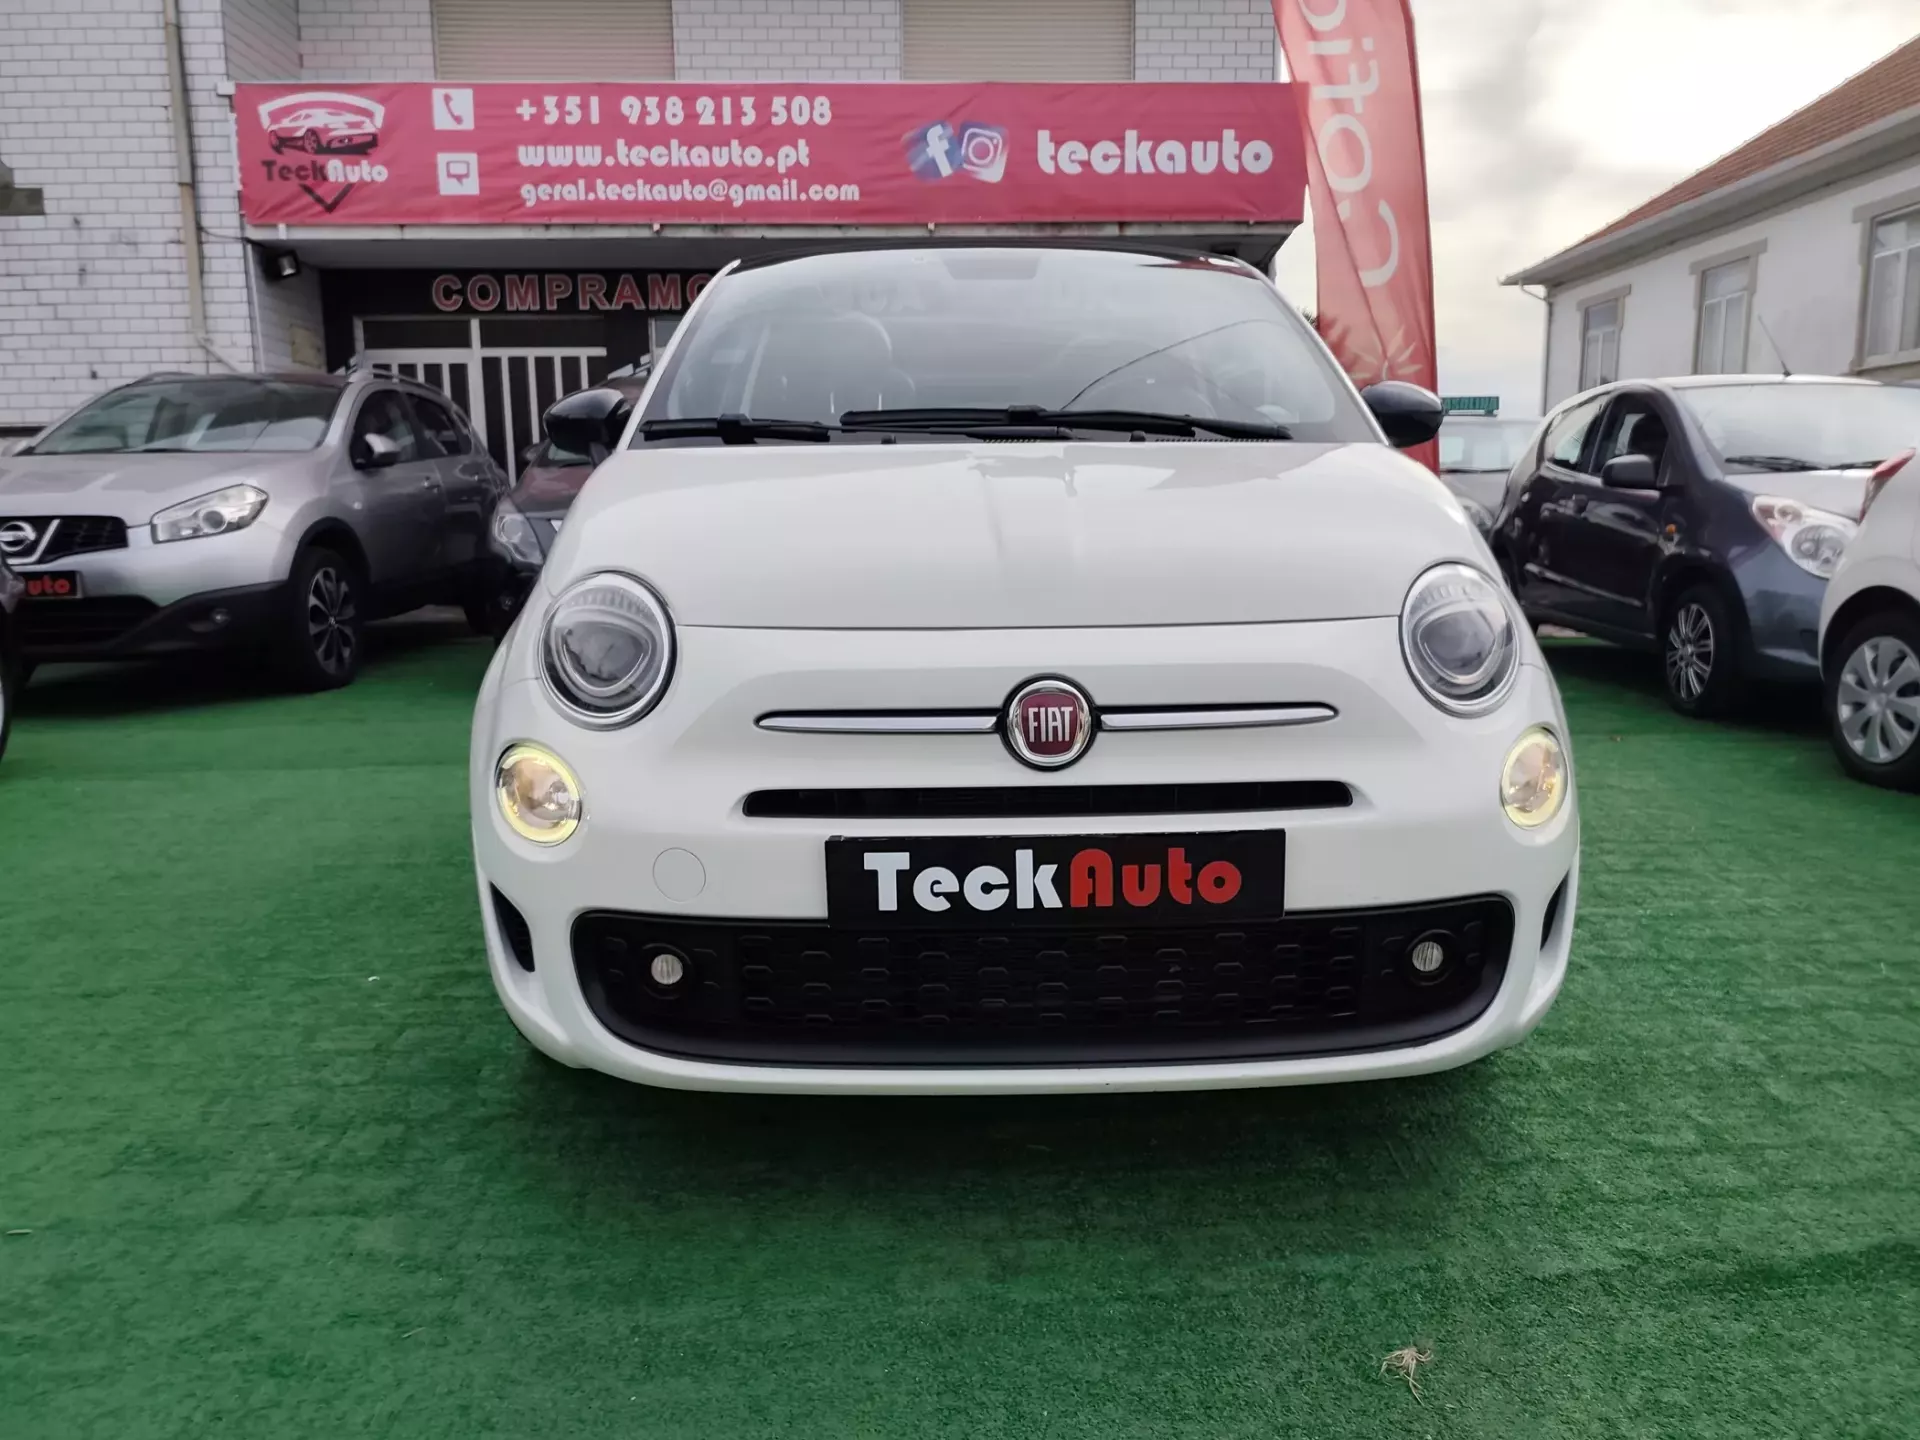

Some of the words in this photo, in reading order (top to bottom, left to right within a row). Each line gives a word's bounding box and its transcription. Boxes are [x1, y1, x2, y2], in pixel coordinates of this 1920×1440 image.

[516, 96, 600, 126] +351
[621, 96, 685, 126] 938
[697, 96, 757, 126] 213
[772, 96, 832, 126] 508
[518, 139, 810, 173] www.teckauto.pt
[1037, 130, 1273, 175] teckauto
[261, 158, 388, 183] TeckAuto
[521, 179, 860, 207] geral.teckauto@gmail.com
[1028, 706, 1074, 743] FIAT
[864, 848, 1242, 912] TeckAuto
